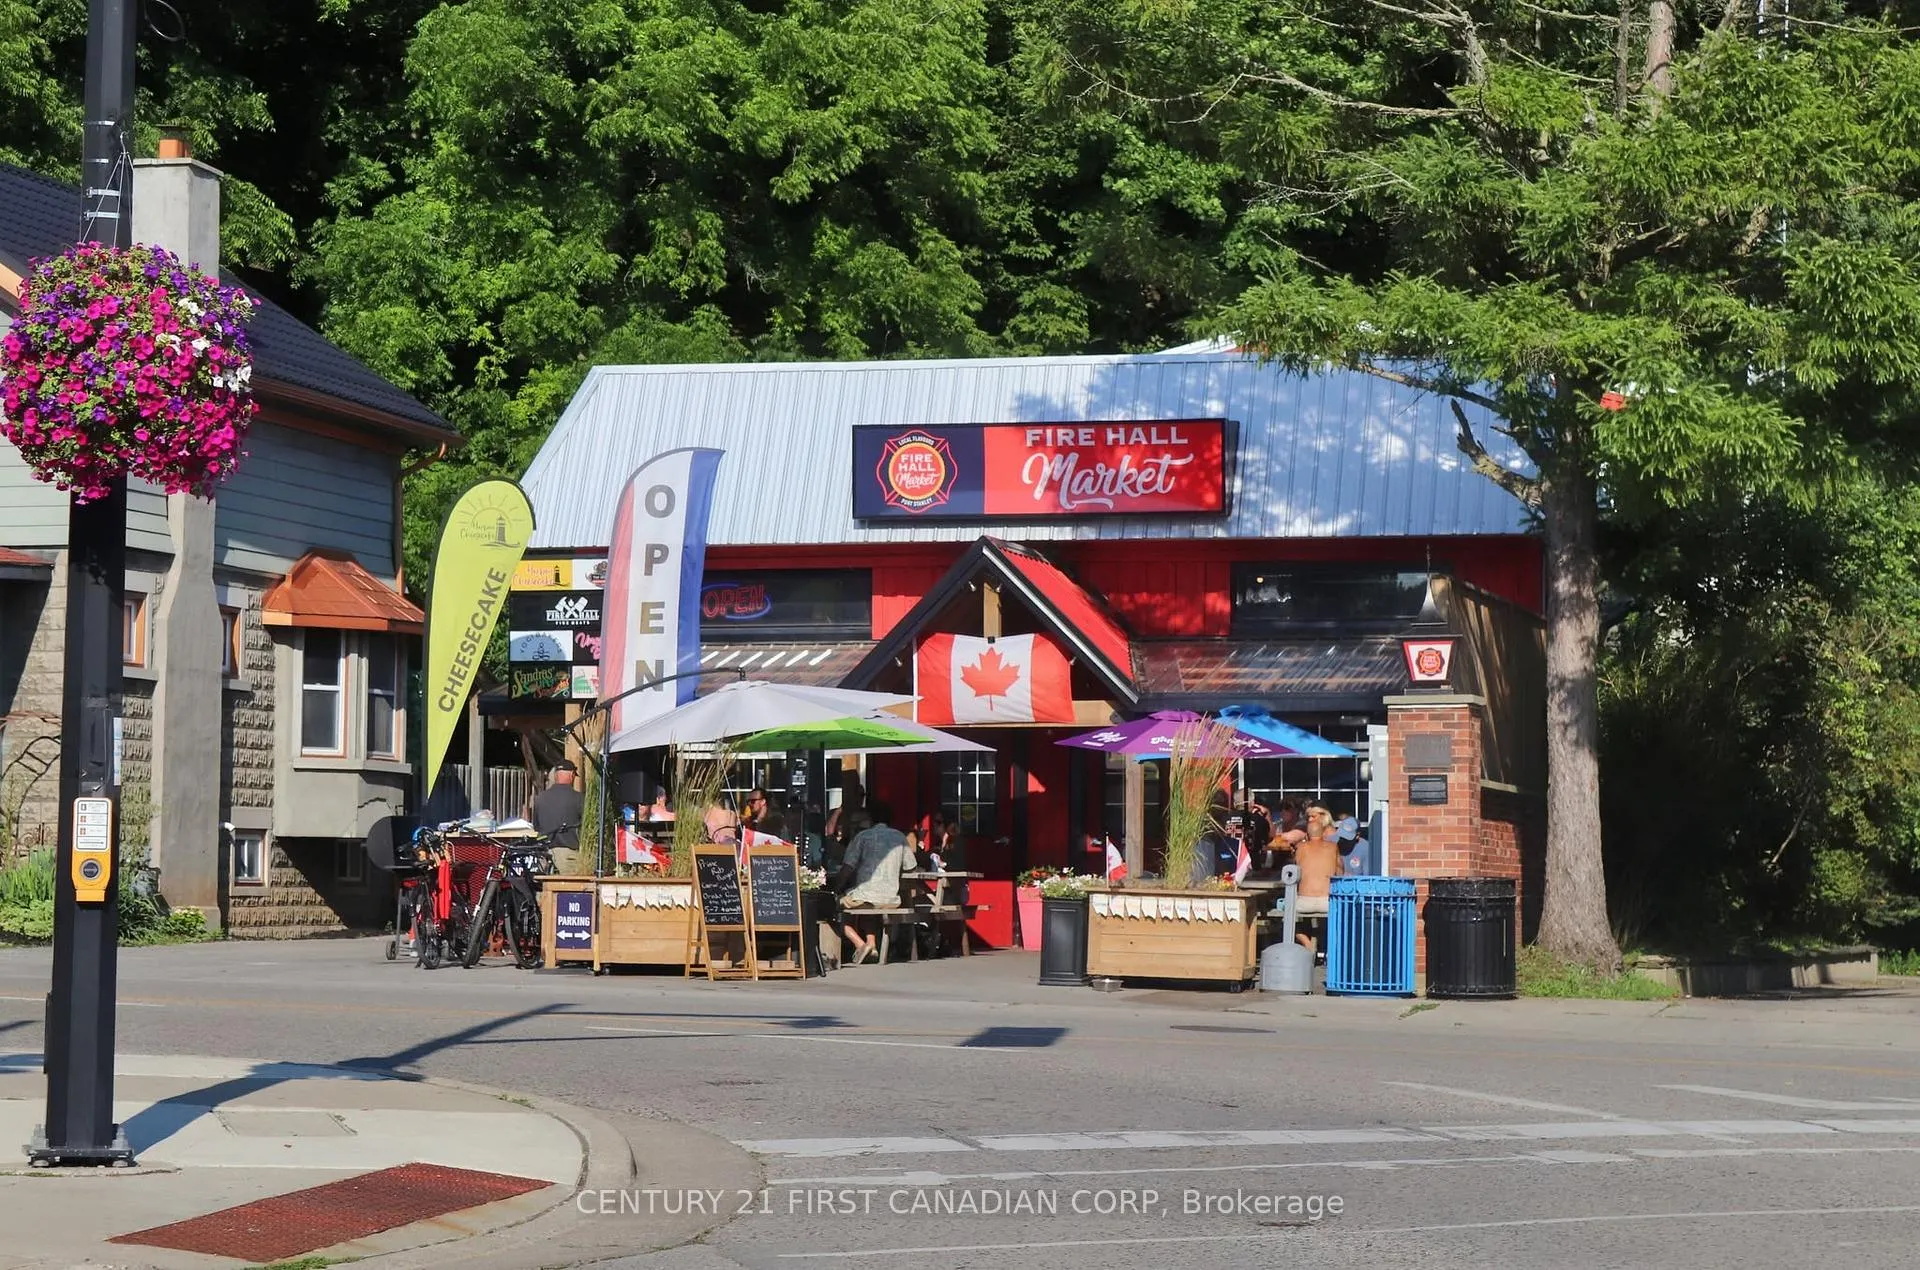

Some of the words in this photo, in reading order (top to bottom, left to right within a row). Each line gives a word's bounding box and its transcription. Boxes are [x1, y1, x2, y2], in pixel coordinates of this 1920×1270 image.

[1025, 428, 1096, 447] FIRE
[1105, 426, 1189, 446] HALL
[898, 463, 936, 472] HALL
[900, 453, 933, 463] FIRE
[895, 472, 940, 490] Market
[1021, 452, 1194, 510] Market
[634, 484, 677, 692] OPEN
[703, 583, 765, 619] OPEN
[438, 567, 507, 714] CHEESECAKE
[569, 902, 580, 913] NO
[557, 915, 590, 927] PARKING
